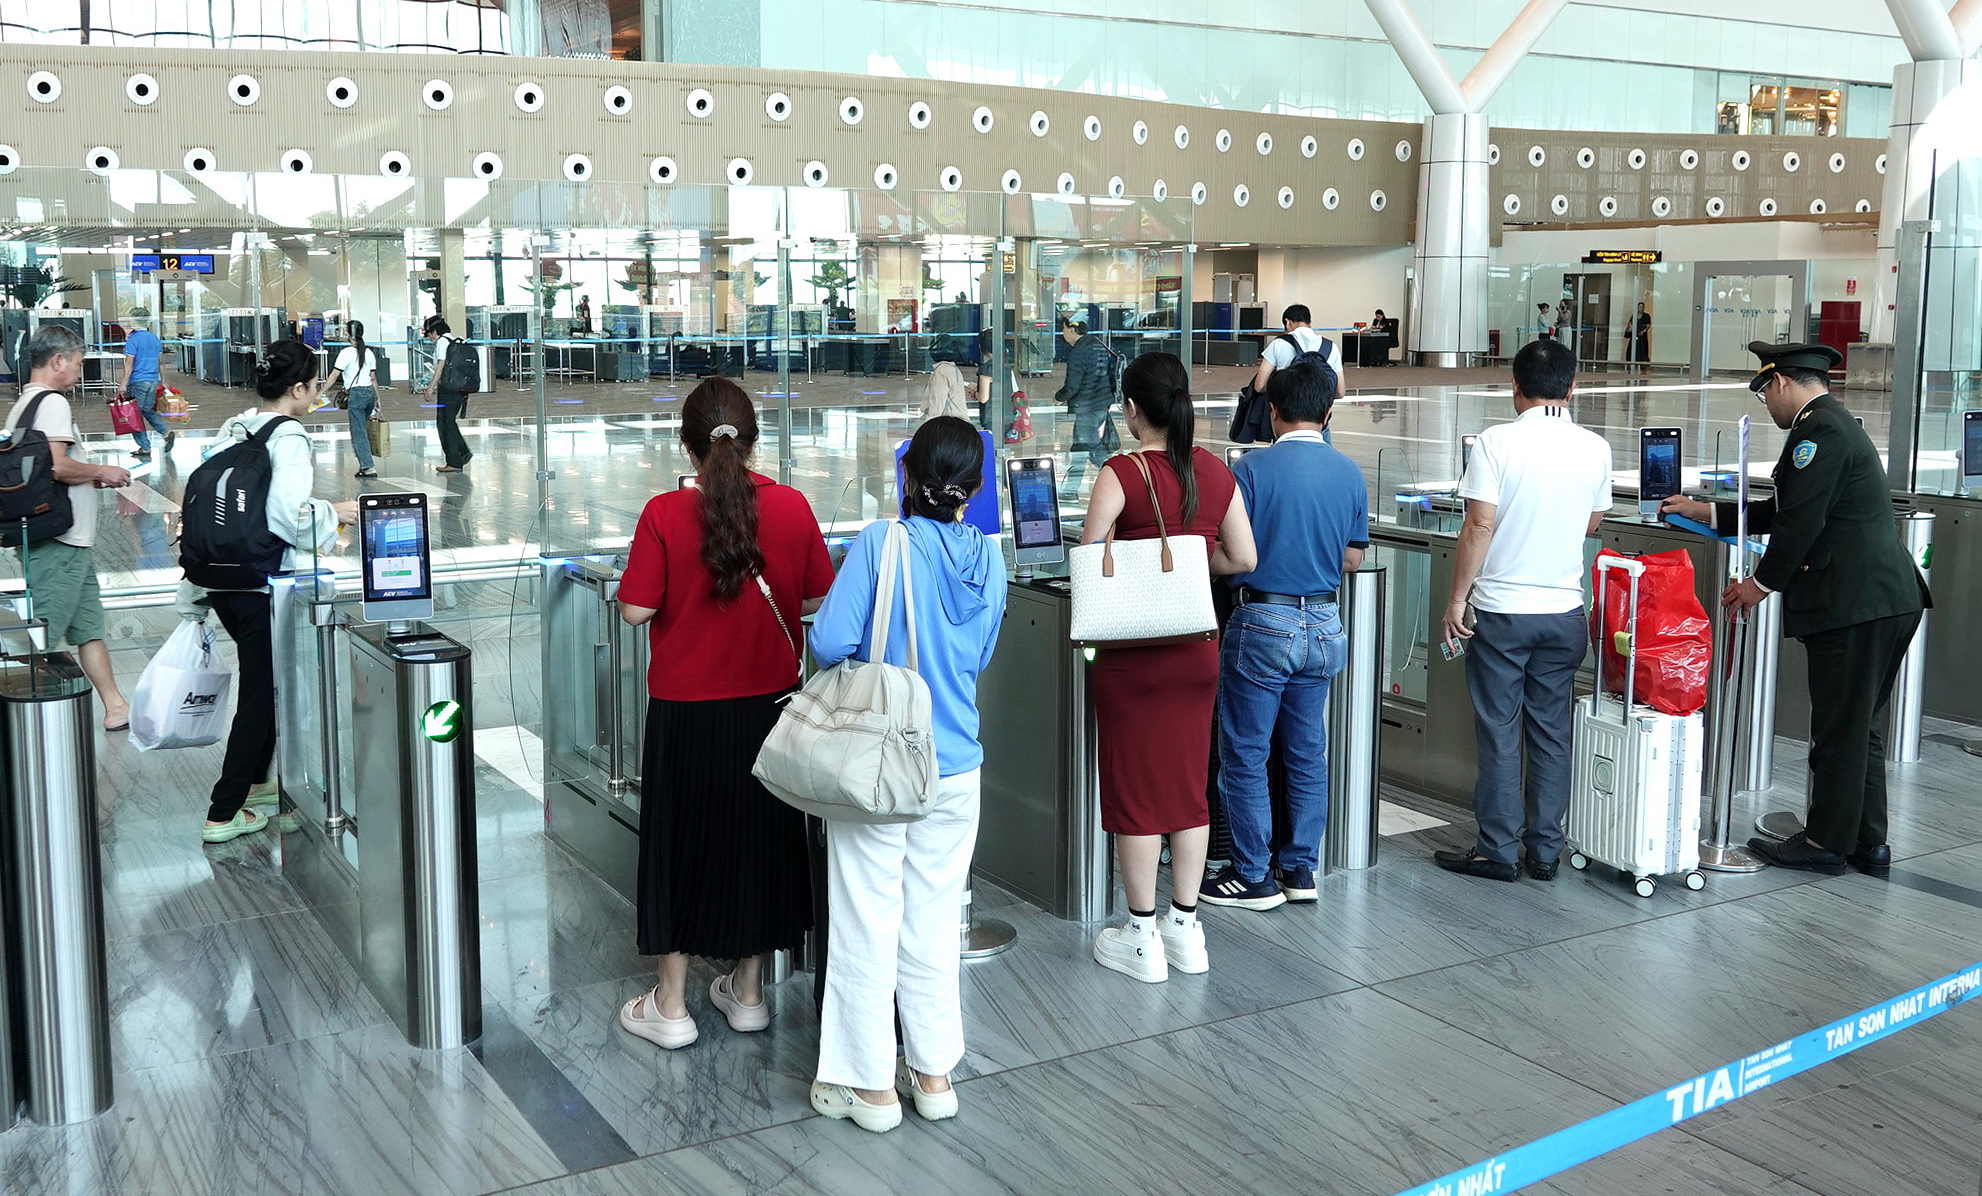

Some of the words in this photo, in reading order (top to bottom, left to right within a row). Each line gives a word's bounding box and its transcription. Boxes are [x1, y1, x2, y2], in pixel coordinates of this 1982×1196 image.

[162, 258, 178, 270] 12
[1826, 1022, 1854, 1051] TAN
[1858, 1009, 1886, 1038] SON
[1890, 992, 1926, 1025] NHAT
[1928, 967, 1982, 1008] INTERNA
[1665, 1068, 1735, 1122] TIA
[1457, 1158, 1506, 1196] NHẤT
